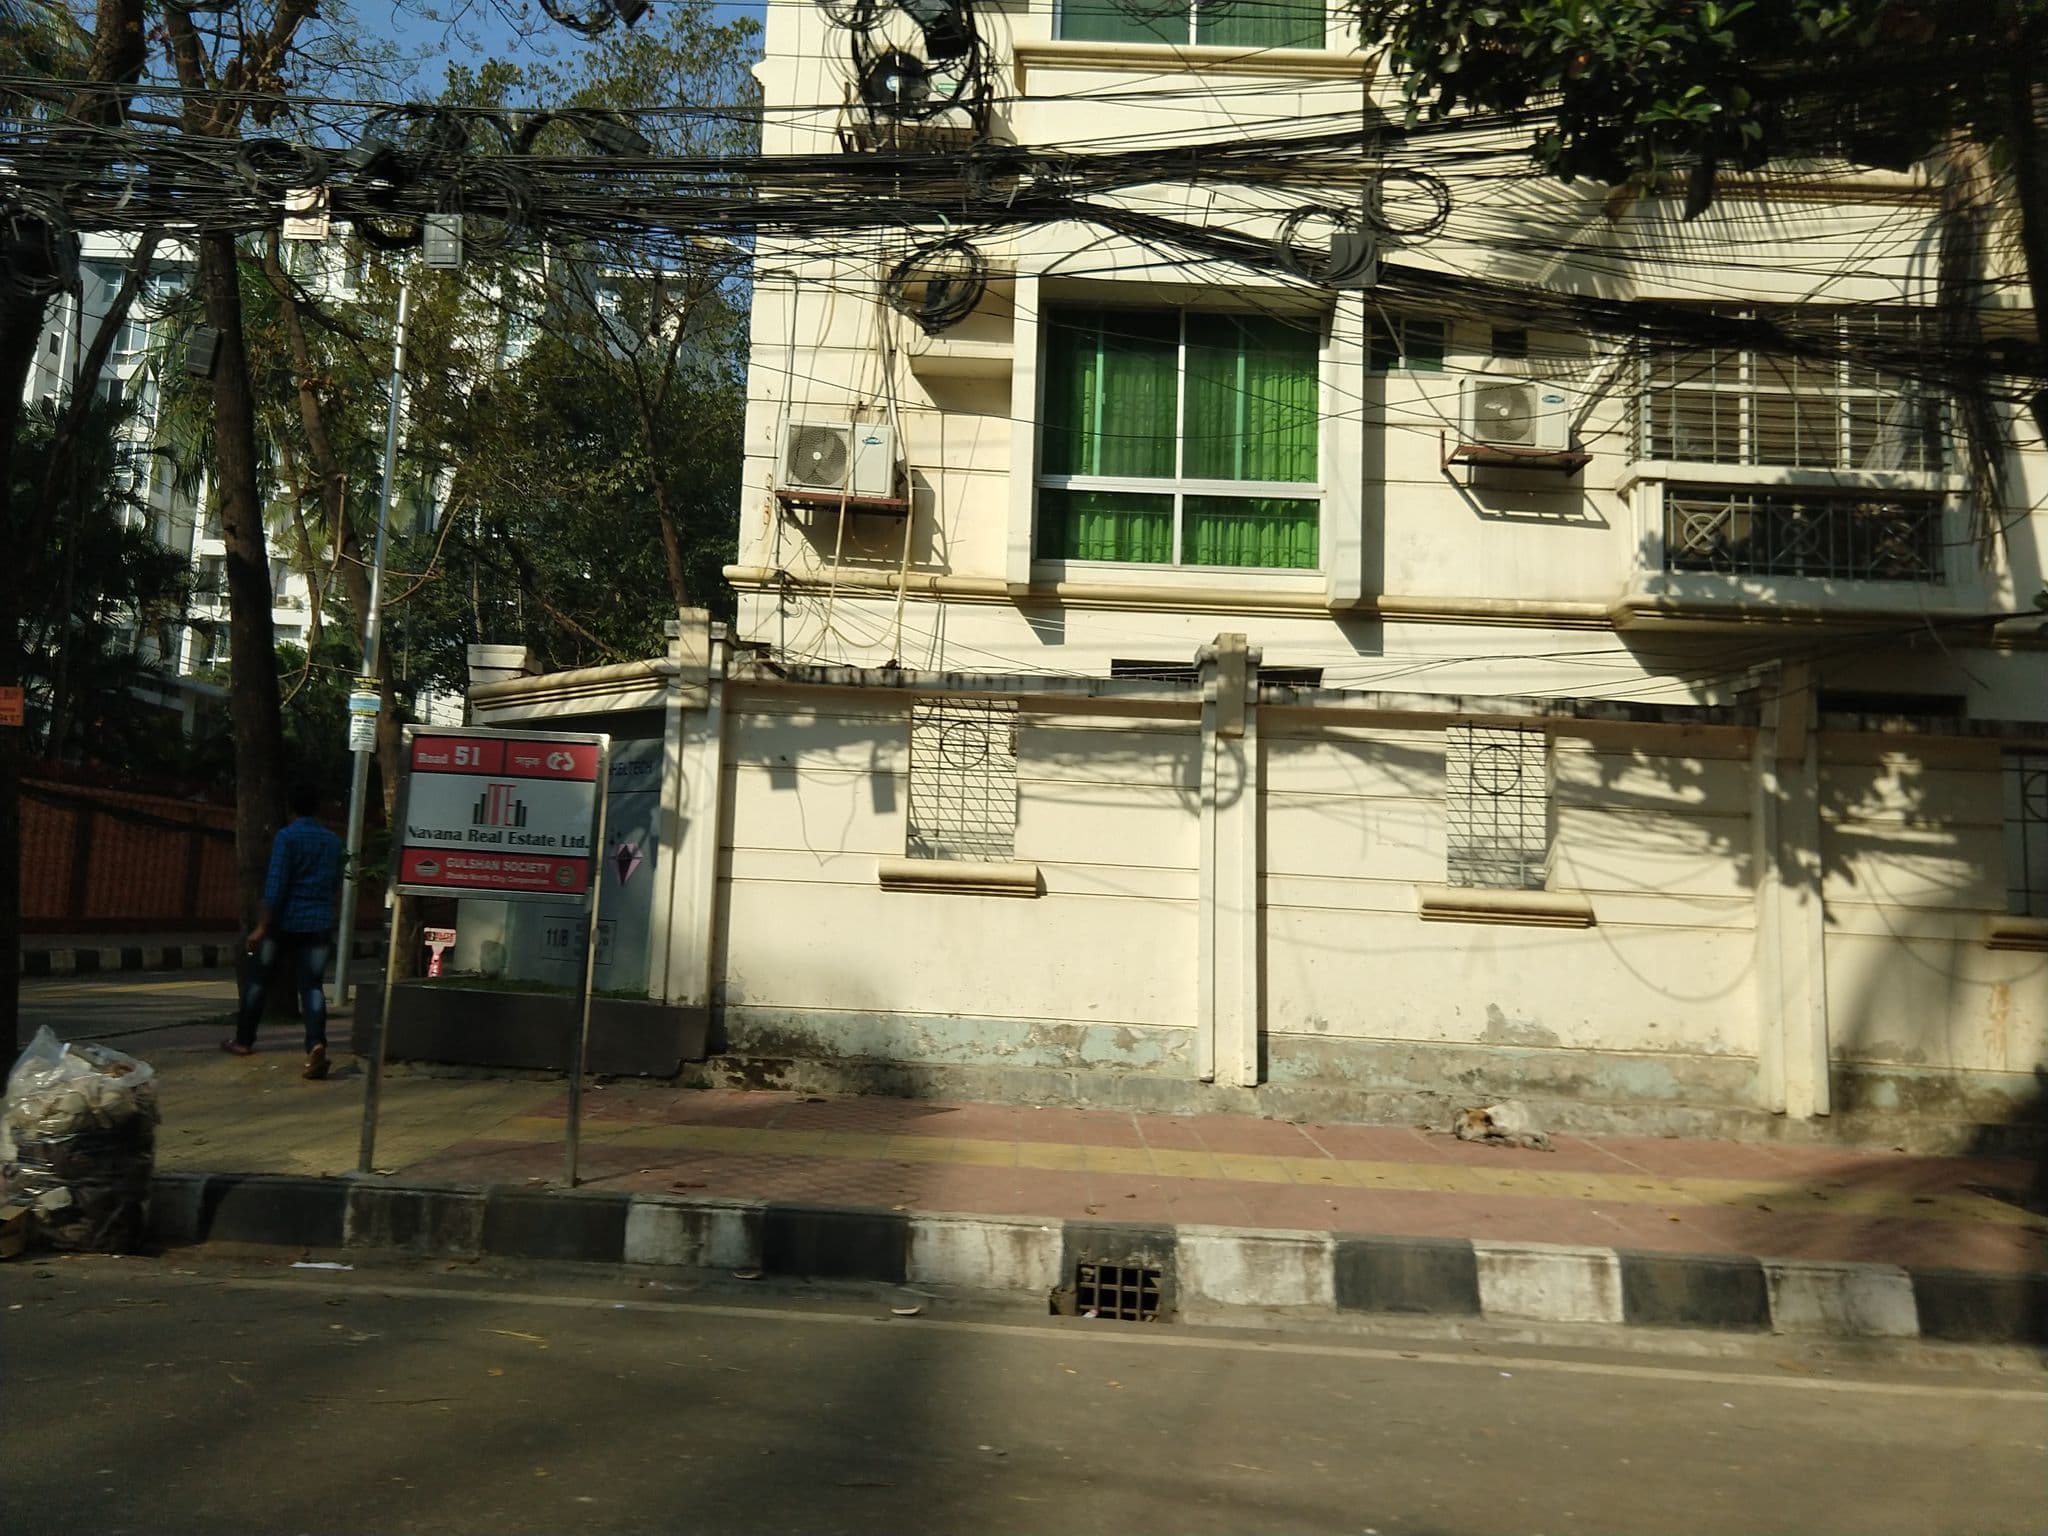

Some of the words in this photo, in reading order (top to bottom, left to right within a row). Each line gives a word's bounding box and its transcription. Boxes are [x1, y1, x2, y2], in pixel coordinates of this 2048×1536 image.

[455, 745, 481, 767] 51
[546, 751, 575, 771] ৫১
[407, 825, 463, 842] Navana
[468, 829, 502, 844] Real
[508, 832, 556, 847] Estate
[561, 834, 590, 849] Ltd.
[446, 857, 500, 871] GULSHAN
[502, 861, 552, 874] SOCIETY
